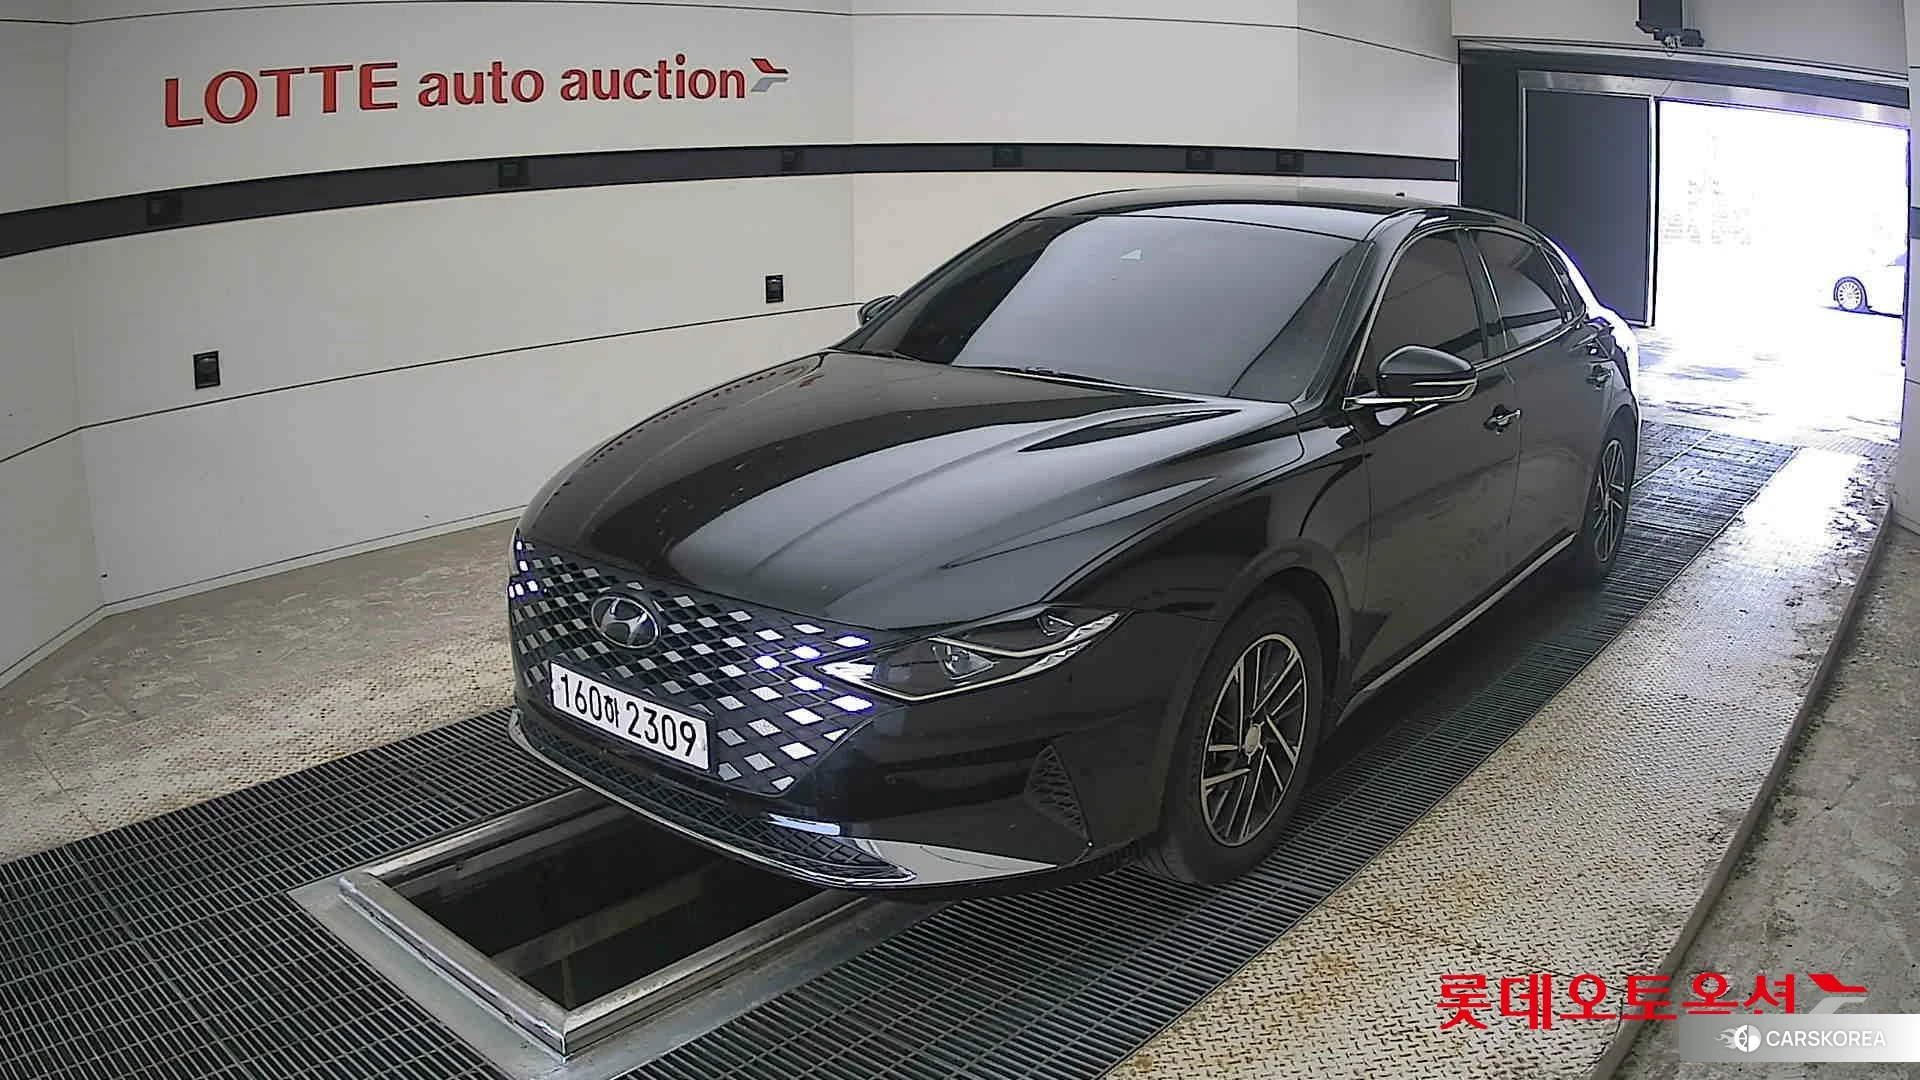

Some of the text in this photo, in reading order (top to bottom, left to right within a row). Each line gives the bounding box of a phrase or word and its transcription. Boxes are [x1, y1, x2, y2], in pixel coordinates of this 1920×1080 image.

[164, 53, 747, 128] LOTTE auto auction
